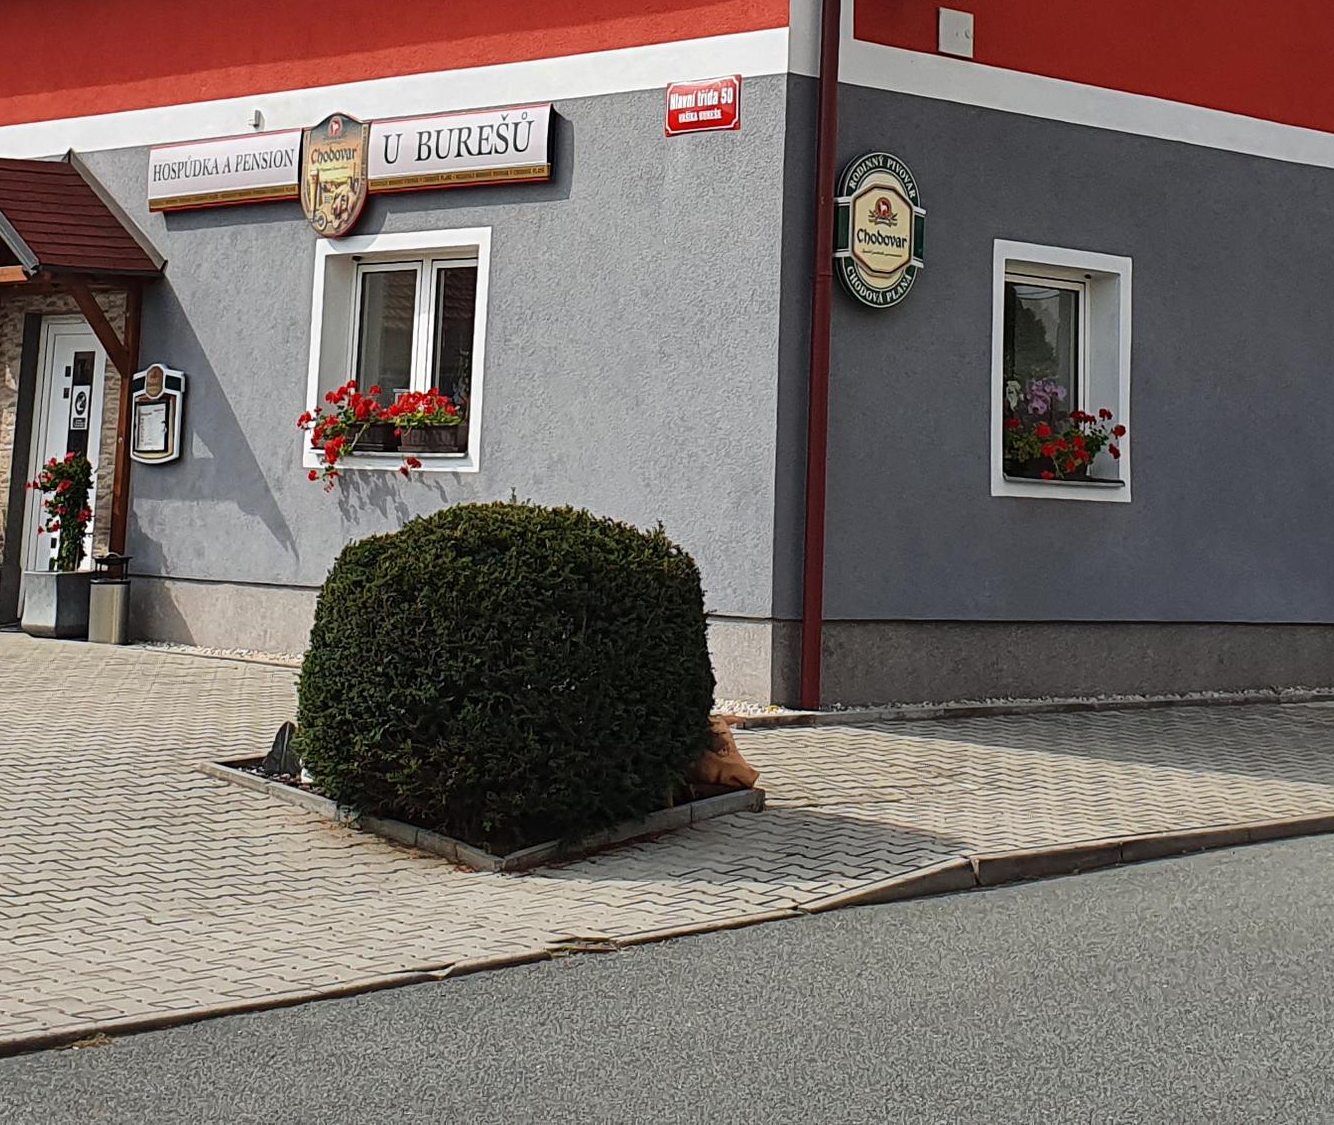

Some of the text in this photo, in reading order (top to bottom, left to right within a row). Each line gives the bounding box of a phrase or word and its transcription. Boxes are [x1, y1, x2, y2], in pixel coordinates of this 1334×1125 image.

[670, 87, 734, 110] Hlavní třída 50
[310, 144, 357, 164] Chodovar
[383, 133, 404, 165] U
[414, 111, 535, 162] BUREŠŮ
[153, 148, 295, 182] HOSPŮDKA A PENSION
[848, 154, 916, 199] RODINNÝ PIVOVAR
[856, 227, 908, 249] Chodovar
[846, 266, 912, 304] CHODOVÁ PLANÁ
